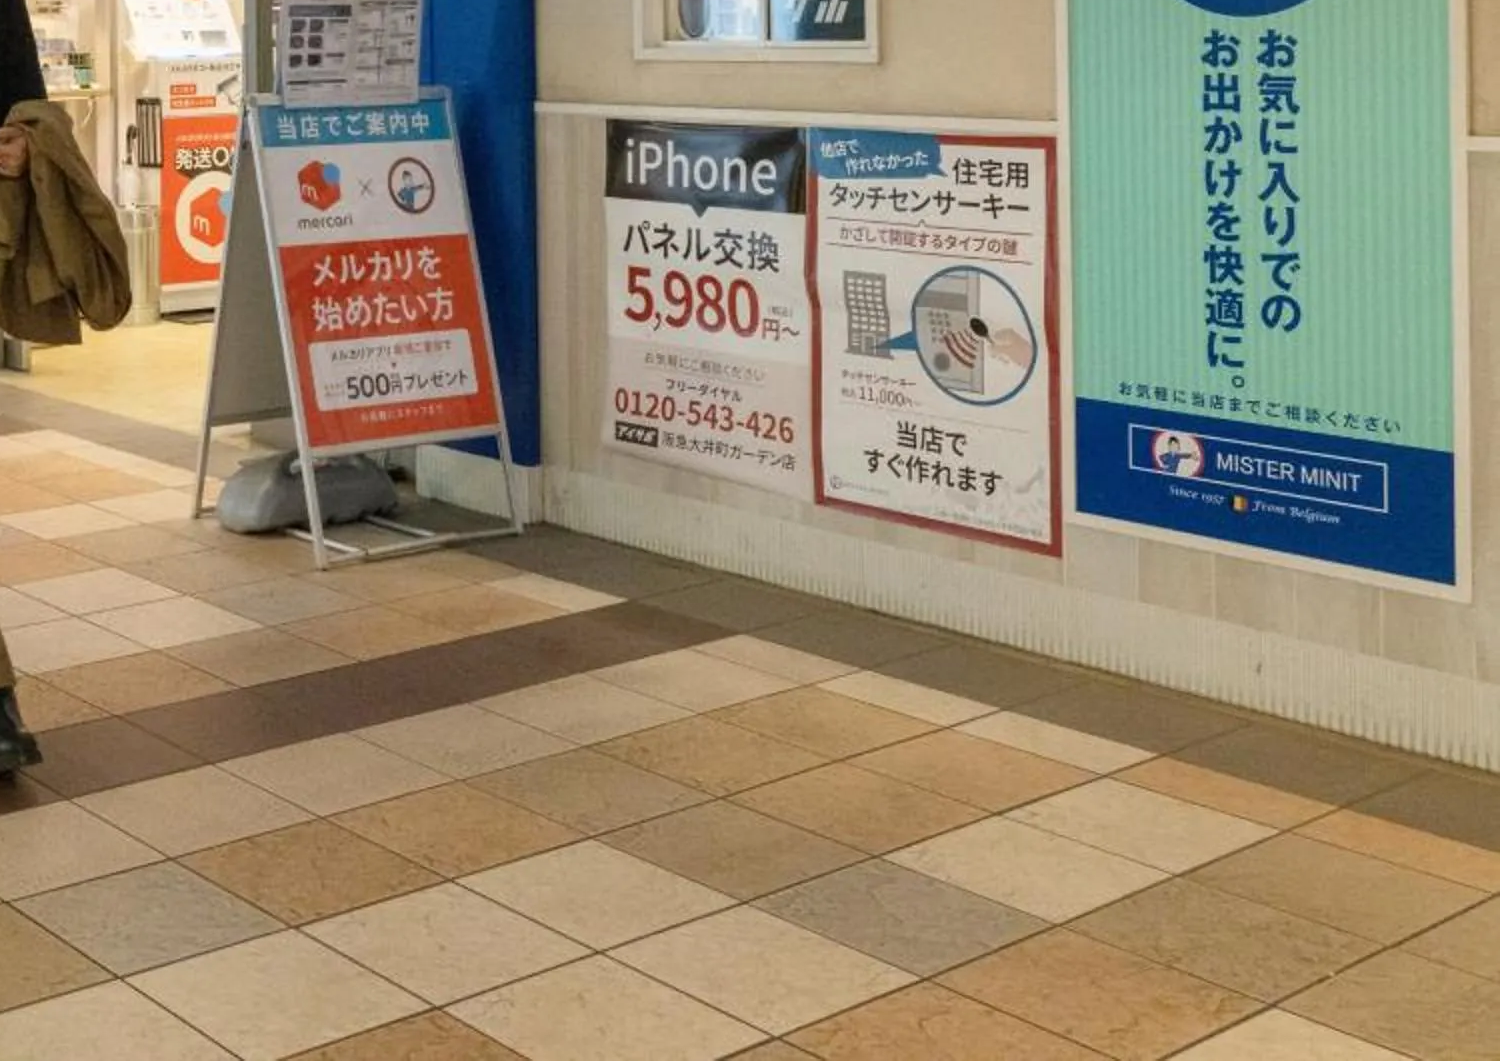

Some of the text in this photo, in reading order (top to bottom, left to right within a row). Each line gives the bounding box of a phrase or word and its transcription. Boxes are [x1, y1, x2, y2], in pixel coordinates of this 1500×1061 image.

[276, 109, 430, 140] 当店でご案内中
[624, 137, 778, 196] iPhone
[819, 138, 859, 158] 他店で
[845, 150, 929, 175] 作れなかった
[951, 157, 1030, 189] 住宅用
[1256, 28, 1302, 333] お気に入りでの
[297, 214, 354, 230] mercari
[829, 182, 1030, 220] タッチセンサーキー
[1200, 28, 1246, 389] お出かけを快適に。
[312, 245, 443, 287] メルカリを
[623, 220, 780, 274] パネル交換
[311, 286, 455, 332] 始めたい方
[644, 351, 767, 382] お気軽にご相談ください
[665, 377, 743, 403] フリーダイヤル
[1118, 380, 1402, 435] お気軽に当店までご相談ください
[614, 386, 795, 444] 0120-543-426
[661, 429, 797, 472] 阪急大井町ガーデン店
[896, 419, 969, 458] 当店で
[863, 448, 1004, 497] すぐ作れます
[1216, 451, 1363, 493] MISTER MINIT
[1169, 484, 1199, 500] Since
[1252, 498, 1286, 514] From
[1290, 503, 1342, 525] Belgium
